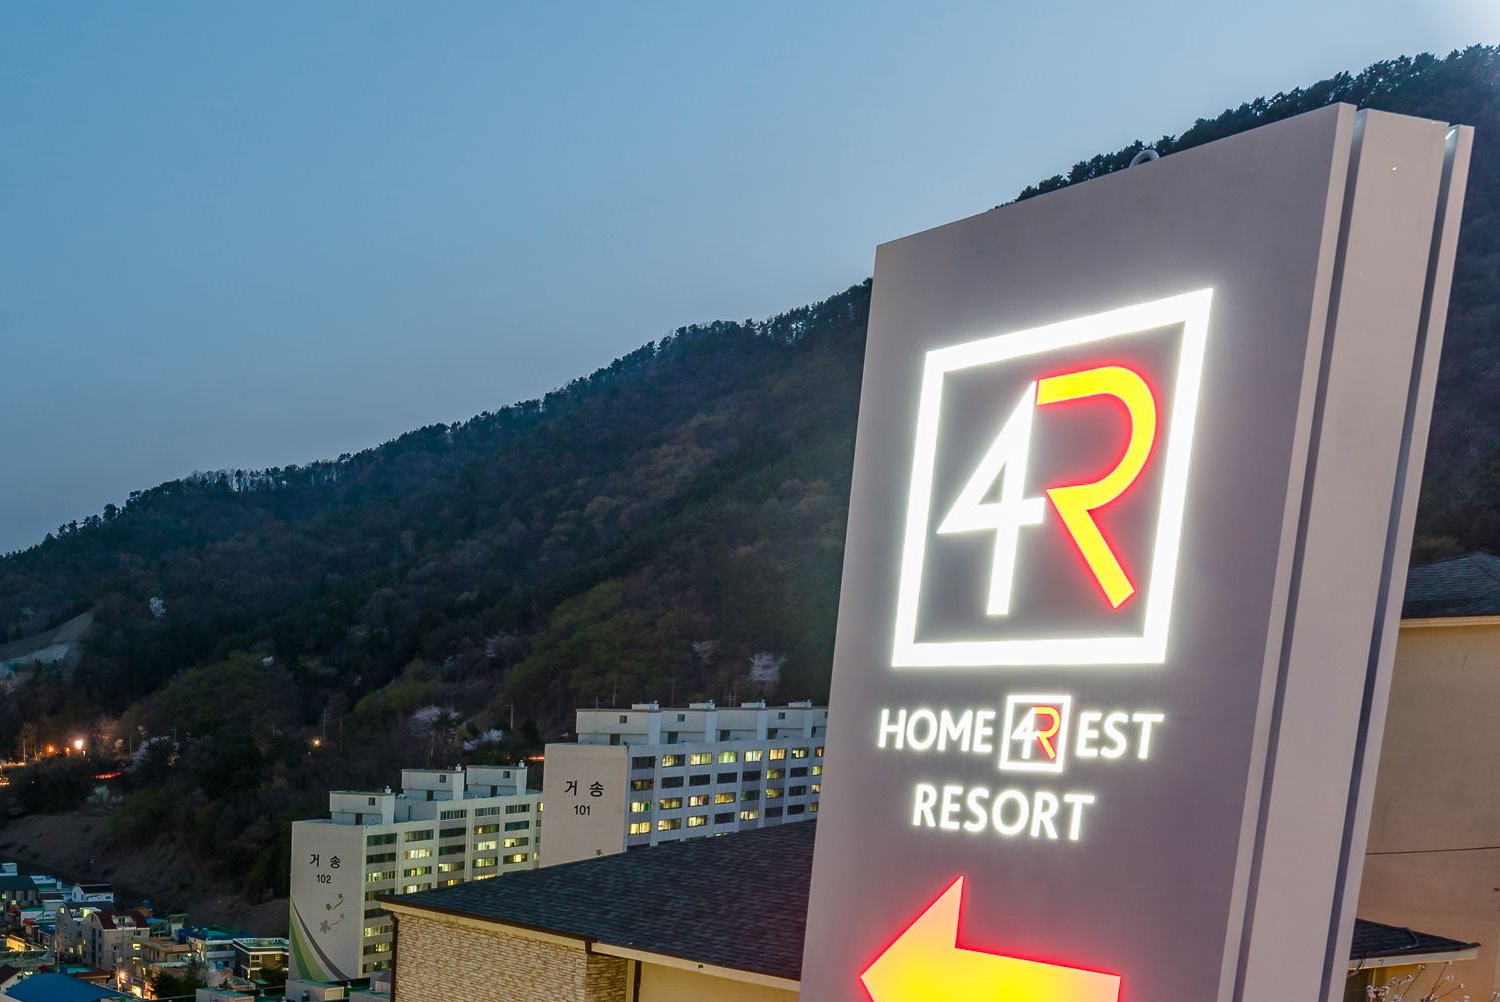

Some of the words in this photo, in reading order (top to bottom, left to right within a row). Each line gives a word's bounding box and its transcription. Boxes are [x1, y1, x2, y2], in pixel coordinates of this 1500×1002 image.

[877, 707, 997, 754] HOME
[1074, 711, 1166, 760] EST
[574, 804, 591, 816] 101
[911, 783, 1096, 841] RESORT
[316, 874, 331, 884] 102
